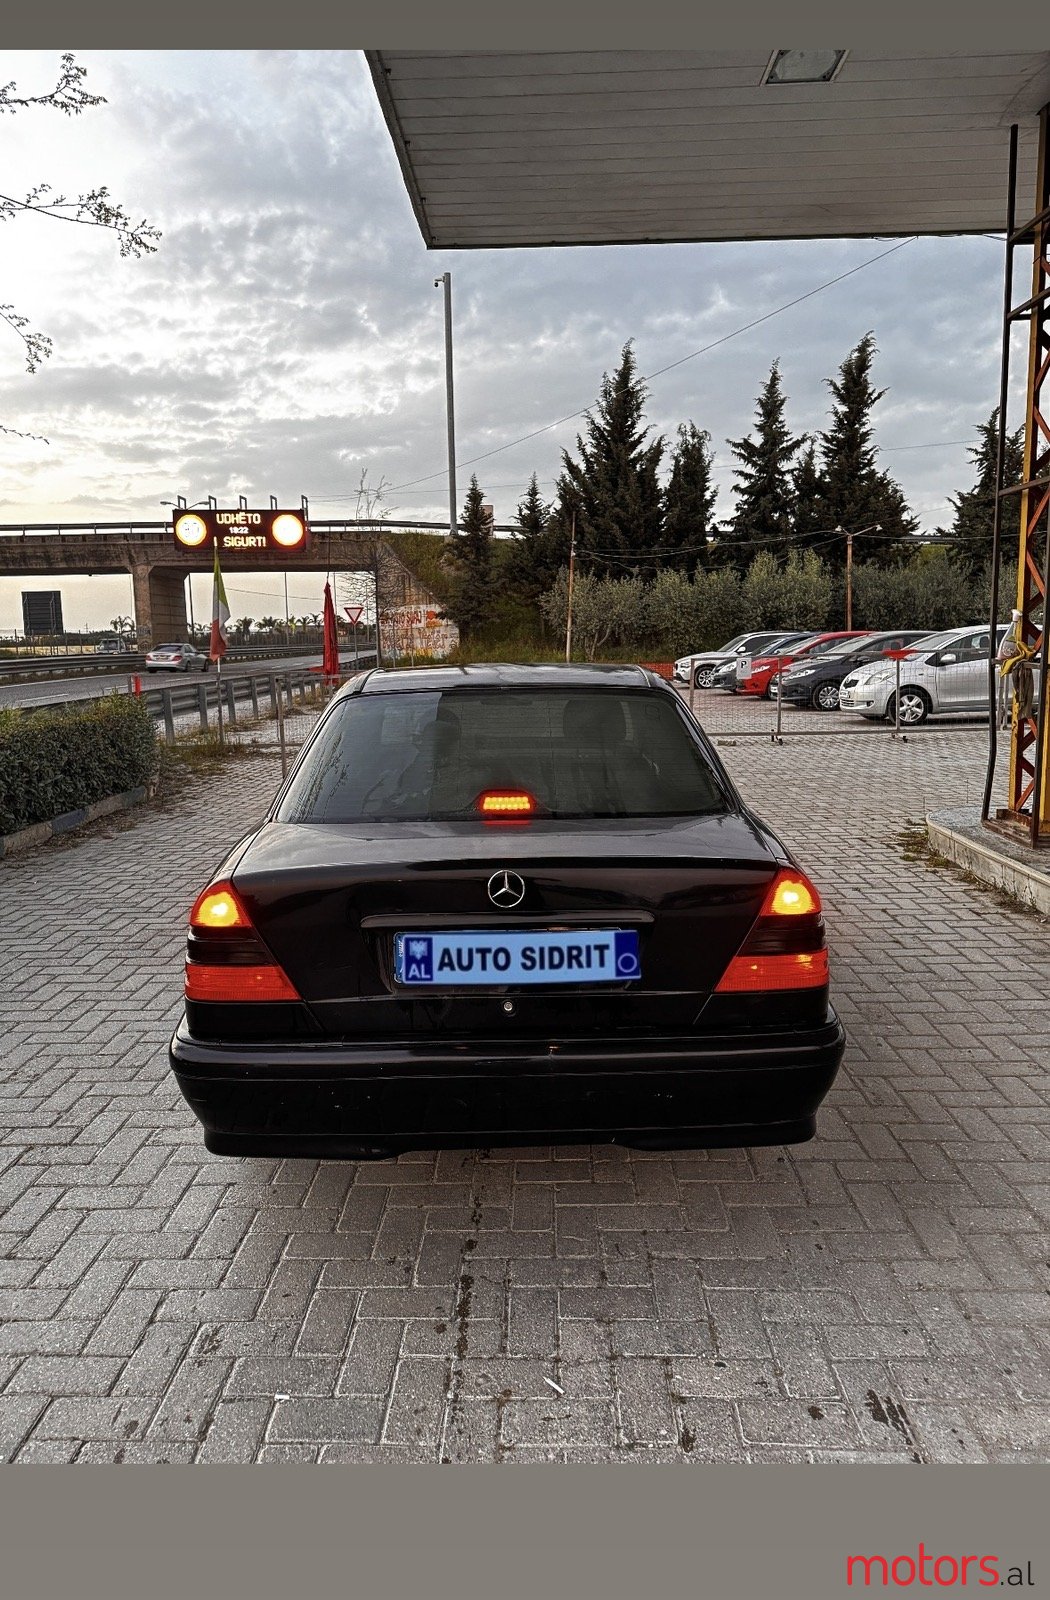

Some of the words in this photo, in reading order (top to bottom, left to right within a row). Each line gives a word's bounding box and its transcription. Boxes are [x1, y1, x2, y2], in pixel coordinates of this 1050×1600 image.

[216, 511, 261, 524] UDHËTO
[740, 660, 747, 668] P
[437, 947, 511, 972] AUTO
[520, 944, 610, 971] SIDRIT
[408, 963, 431, 979] AL
